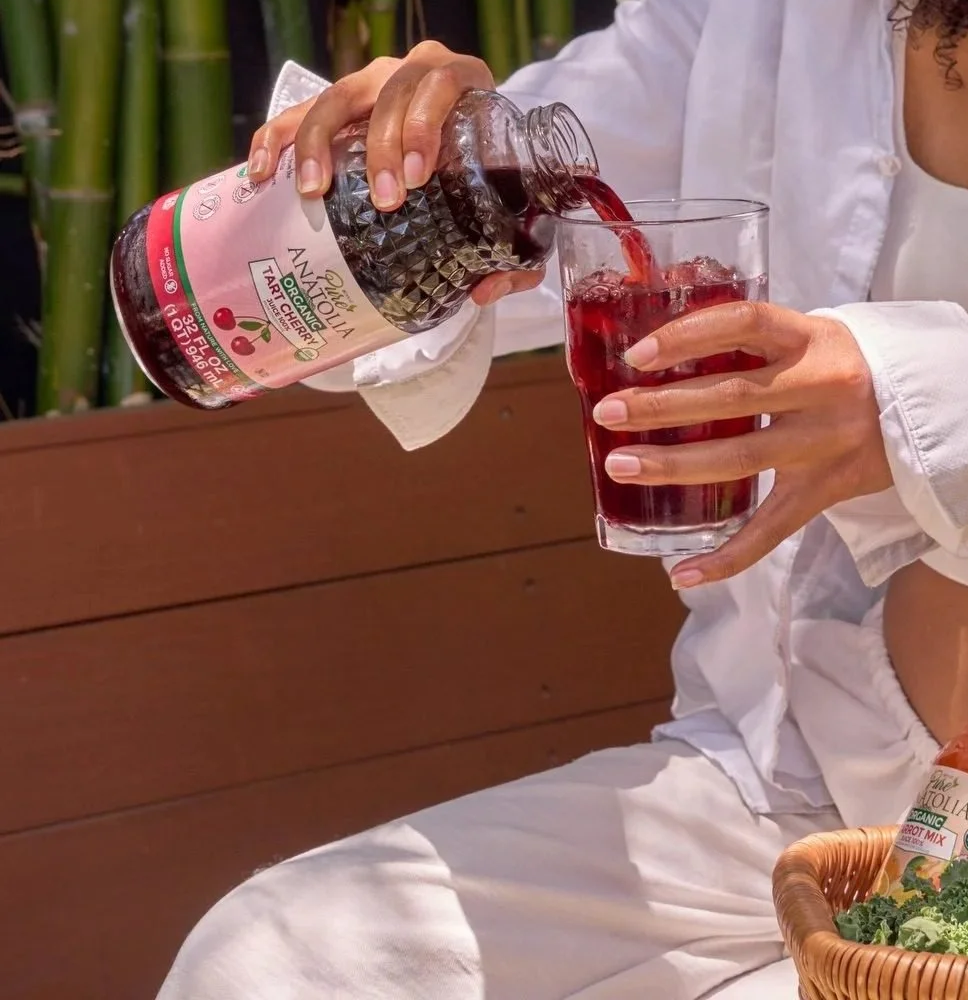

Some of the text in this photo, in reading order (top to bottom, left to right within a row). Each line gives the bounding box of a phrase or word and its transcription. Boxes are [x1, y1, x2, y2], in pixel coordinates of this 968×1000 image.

[166, 256, 174, 277] SUGAR
[288, 248, 355, 339] ANATOLIA
[316, 270, 349, 309] Pure
[262, 266, 286, 300] TART
[280, 304, 318, 345] CHERRY
[267, 298, 281, 317] JUICE
[278, 316, 290, 332] 100%
[284, 277, 322, 330] ORGANIC
[164, 304, 178, 317] (1
[186, 346, 208, 369] 946
[203, 370, 223, 389] mL
[182, 314, 228, 375] 32 FL OZ
[192, 302, 204, 324] FROM
[200, 322, 218, 348] NATURE
[215, 346, 228, 363] WITH
[226, 361, 239, 374] LOVE
[924, 828, 948, 847] MIX
